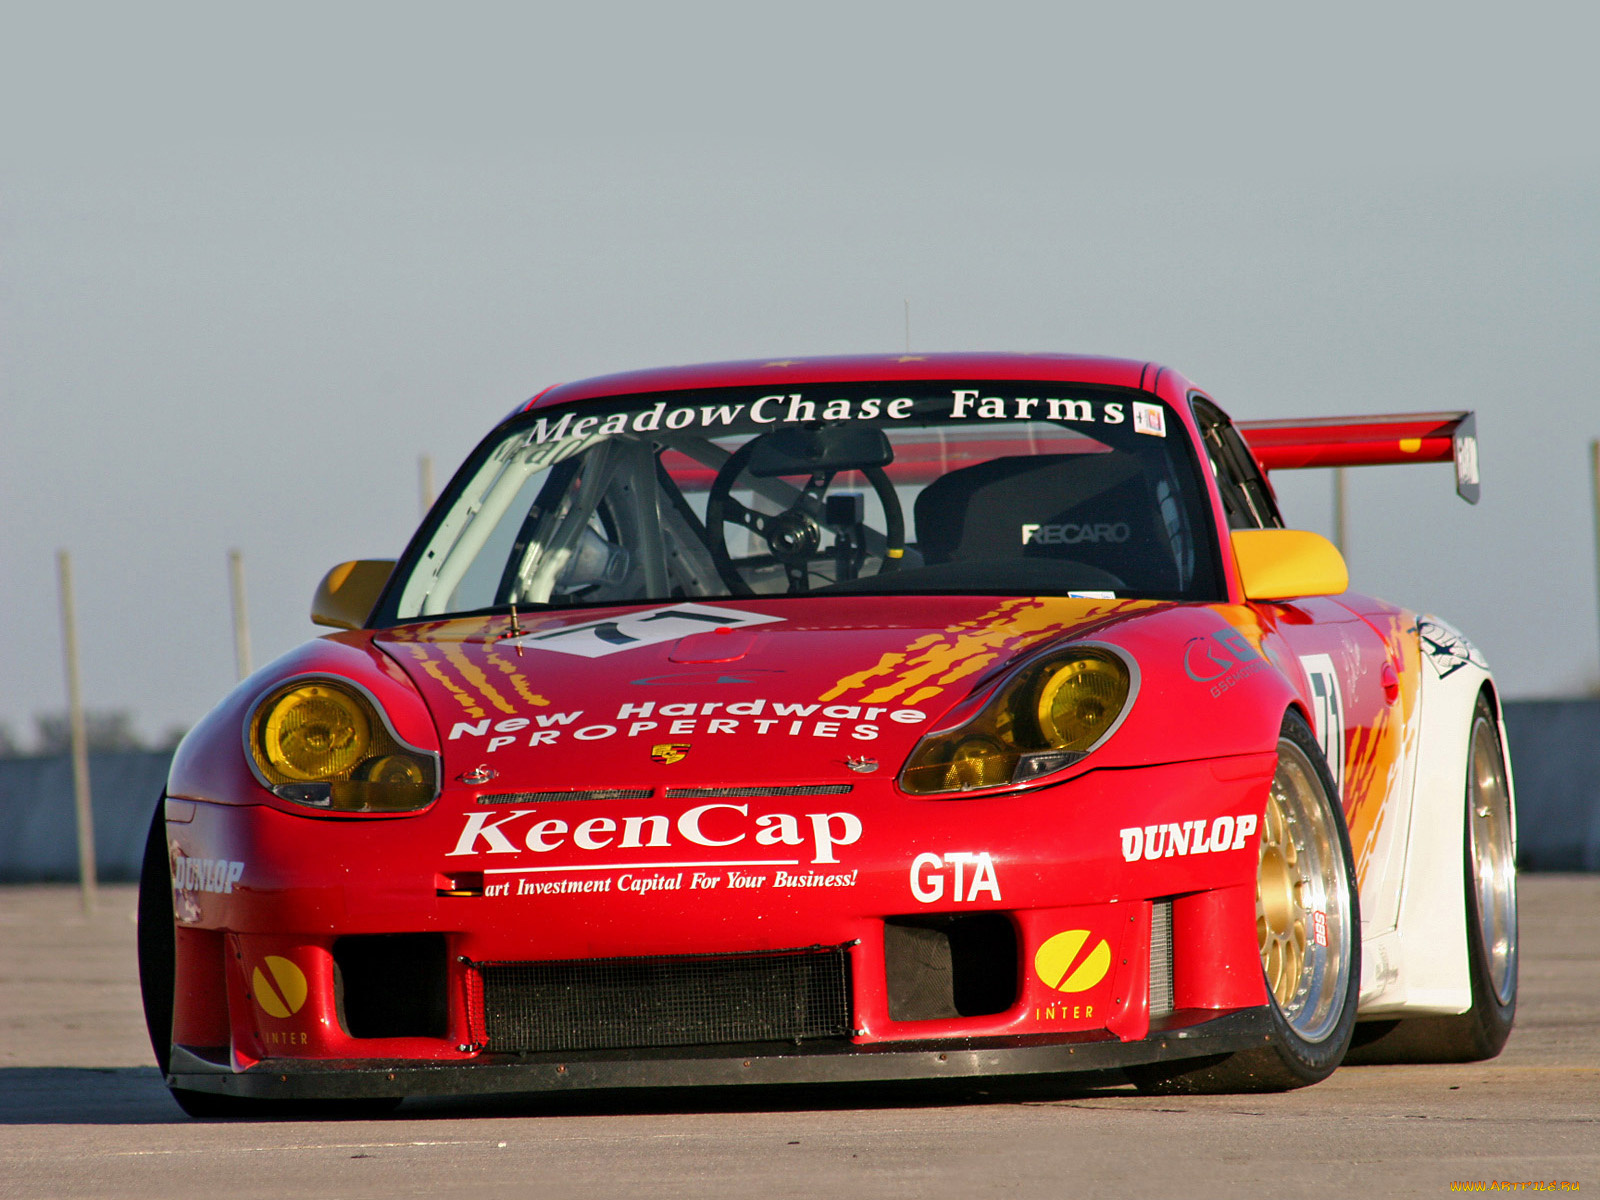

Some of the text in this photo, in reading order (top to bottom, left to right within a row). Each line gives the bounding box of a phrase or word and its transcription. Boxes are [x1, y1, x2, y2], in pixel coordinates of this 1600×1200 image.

[949, 390, 1126, 424] Farms
[1022, 523, 1129, 545] RECARO
[448, 699, 927, 740] New Hardware
[486, 719, 879, 753] PROPERTIES
[445, 803, 864, 864] KeenCap
[1119, 814, 1258, 862] DUNLOP
[175, 856, 245, 894] DUNLOP
[484, 869, 858, 897] art Investment Capital For Your Business!
[909, 852, 1002, 904] GTA
[1036, 1005, 1094, 1021] INTER
[265, 1032, 308, 1045] INTER
